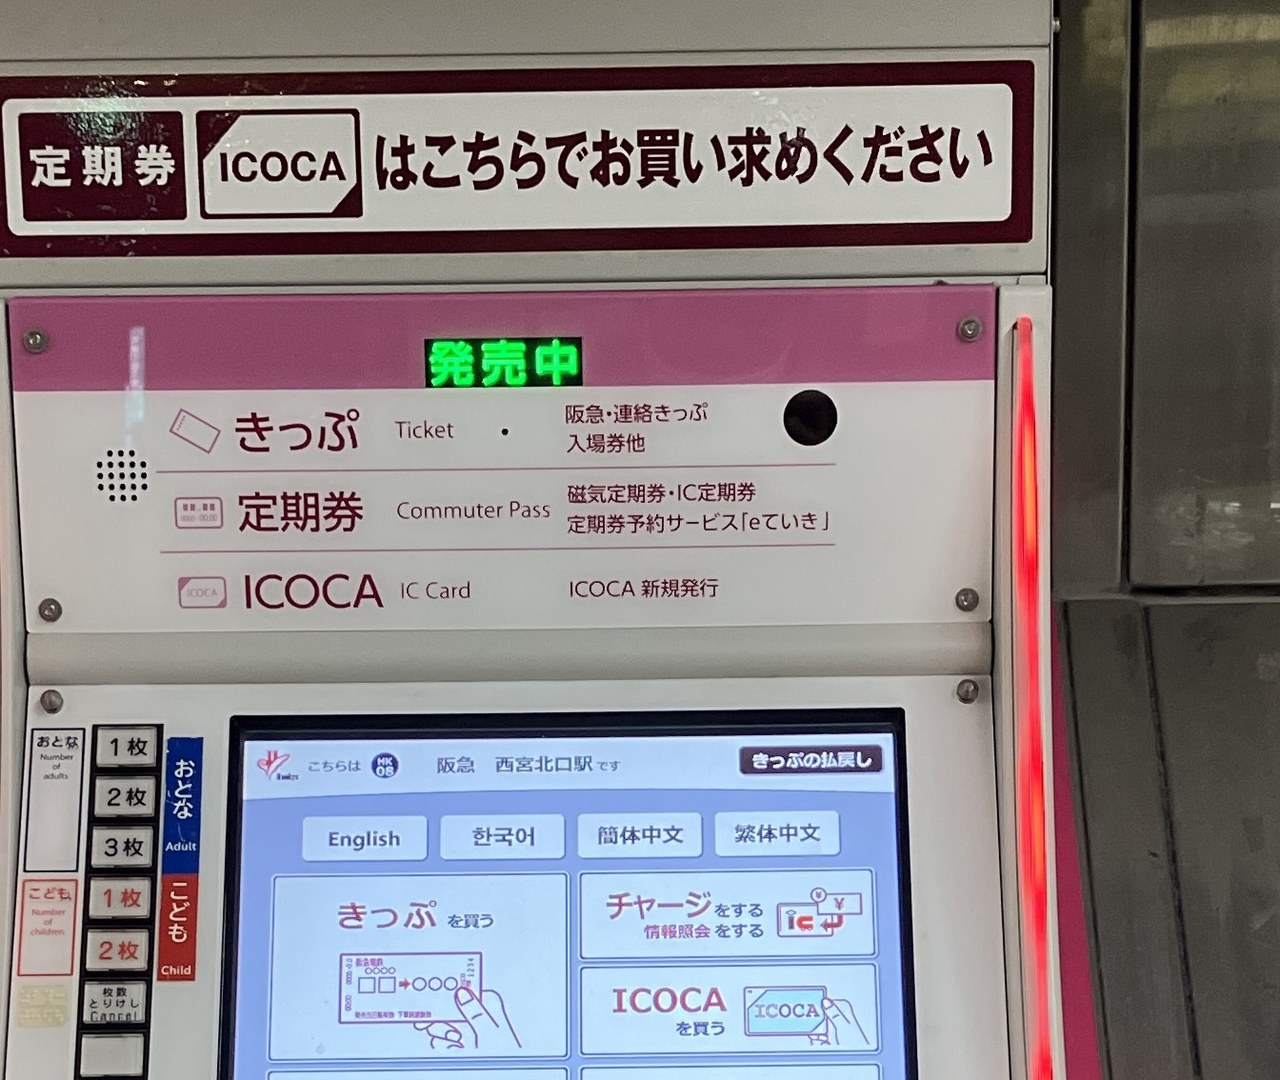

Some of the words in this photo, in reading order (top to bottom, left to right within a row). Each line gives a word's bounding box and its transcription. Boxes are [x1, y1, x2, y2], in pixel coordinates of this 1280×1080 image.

[28, 144, 176, 187] 定期券
[219, 150, 347, 183] ICOCA
[375, 123, 994, 191] はこちらでお買い求めください
[428, 339, 581, 388] 発売中
[565, 402, 709, 425] 阪急・連絡きっぷ
[234, 408, 360, 452] きっぷ
[394, 421, 455, 440] Ticket
[566, 433, 646, 454] 入場券他
[567, 482, 756, 505] 磁気定期券・IC定期券
[237, 490, 364, 533] 定期券
[396, 501, 504, 520] Commuter
[509, 500, 551, 519] Pass
[566, 511, 830, 534] 定期券予約サービス「eていき」
[244, 573, 385, 609] ICOCA
[400, 582, 420, 600] IC
[425, 580, 471, 600] Card
[569, 580, 636, 599] ICOCA
[641, 578, 720, 599] 新規発行
[36, 736, 79, 749] おとな
[40, 753, 74, 761] Number
[308, 759, 361, 773] こちらは
[377, 757, 394, 767] HK
[436, 756, 476, 774] 阪急
[751, 752, 873, 770] きっぷの払戻し
[172, 758, 196, 820] おとな
[328, 830, 401, 850] English
[472, 826, 536, 848] 한국어
[598, 824, 684, 845] 簡体中文
[734, 822, 822, 844] 繁体中文
[165, 841, 198, 852] Adult
[28, 888, 70, 900] こども
[167, 881, 191, 943] こども
[160, 965, 192, 976] Child
[89, 999, 140, 1009] とりけし
[612, 986, 728, 1014] ICOCA
[754, 1003, 820, 1019] ICOCA
[675, 1021, 726, 1037] を買う
